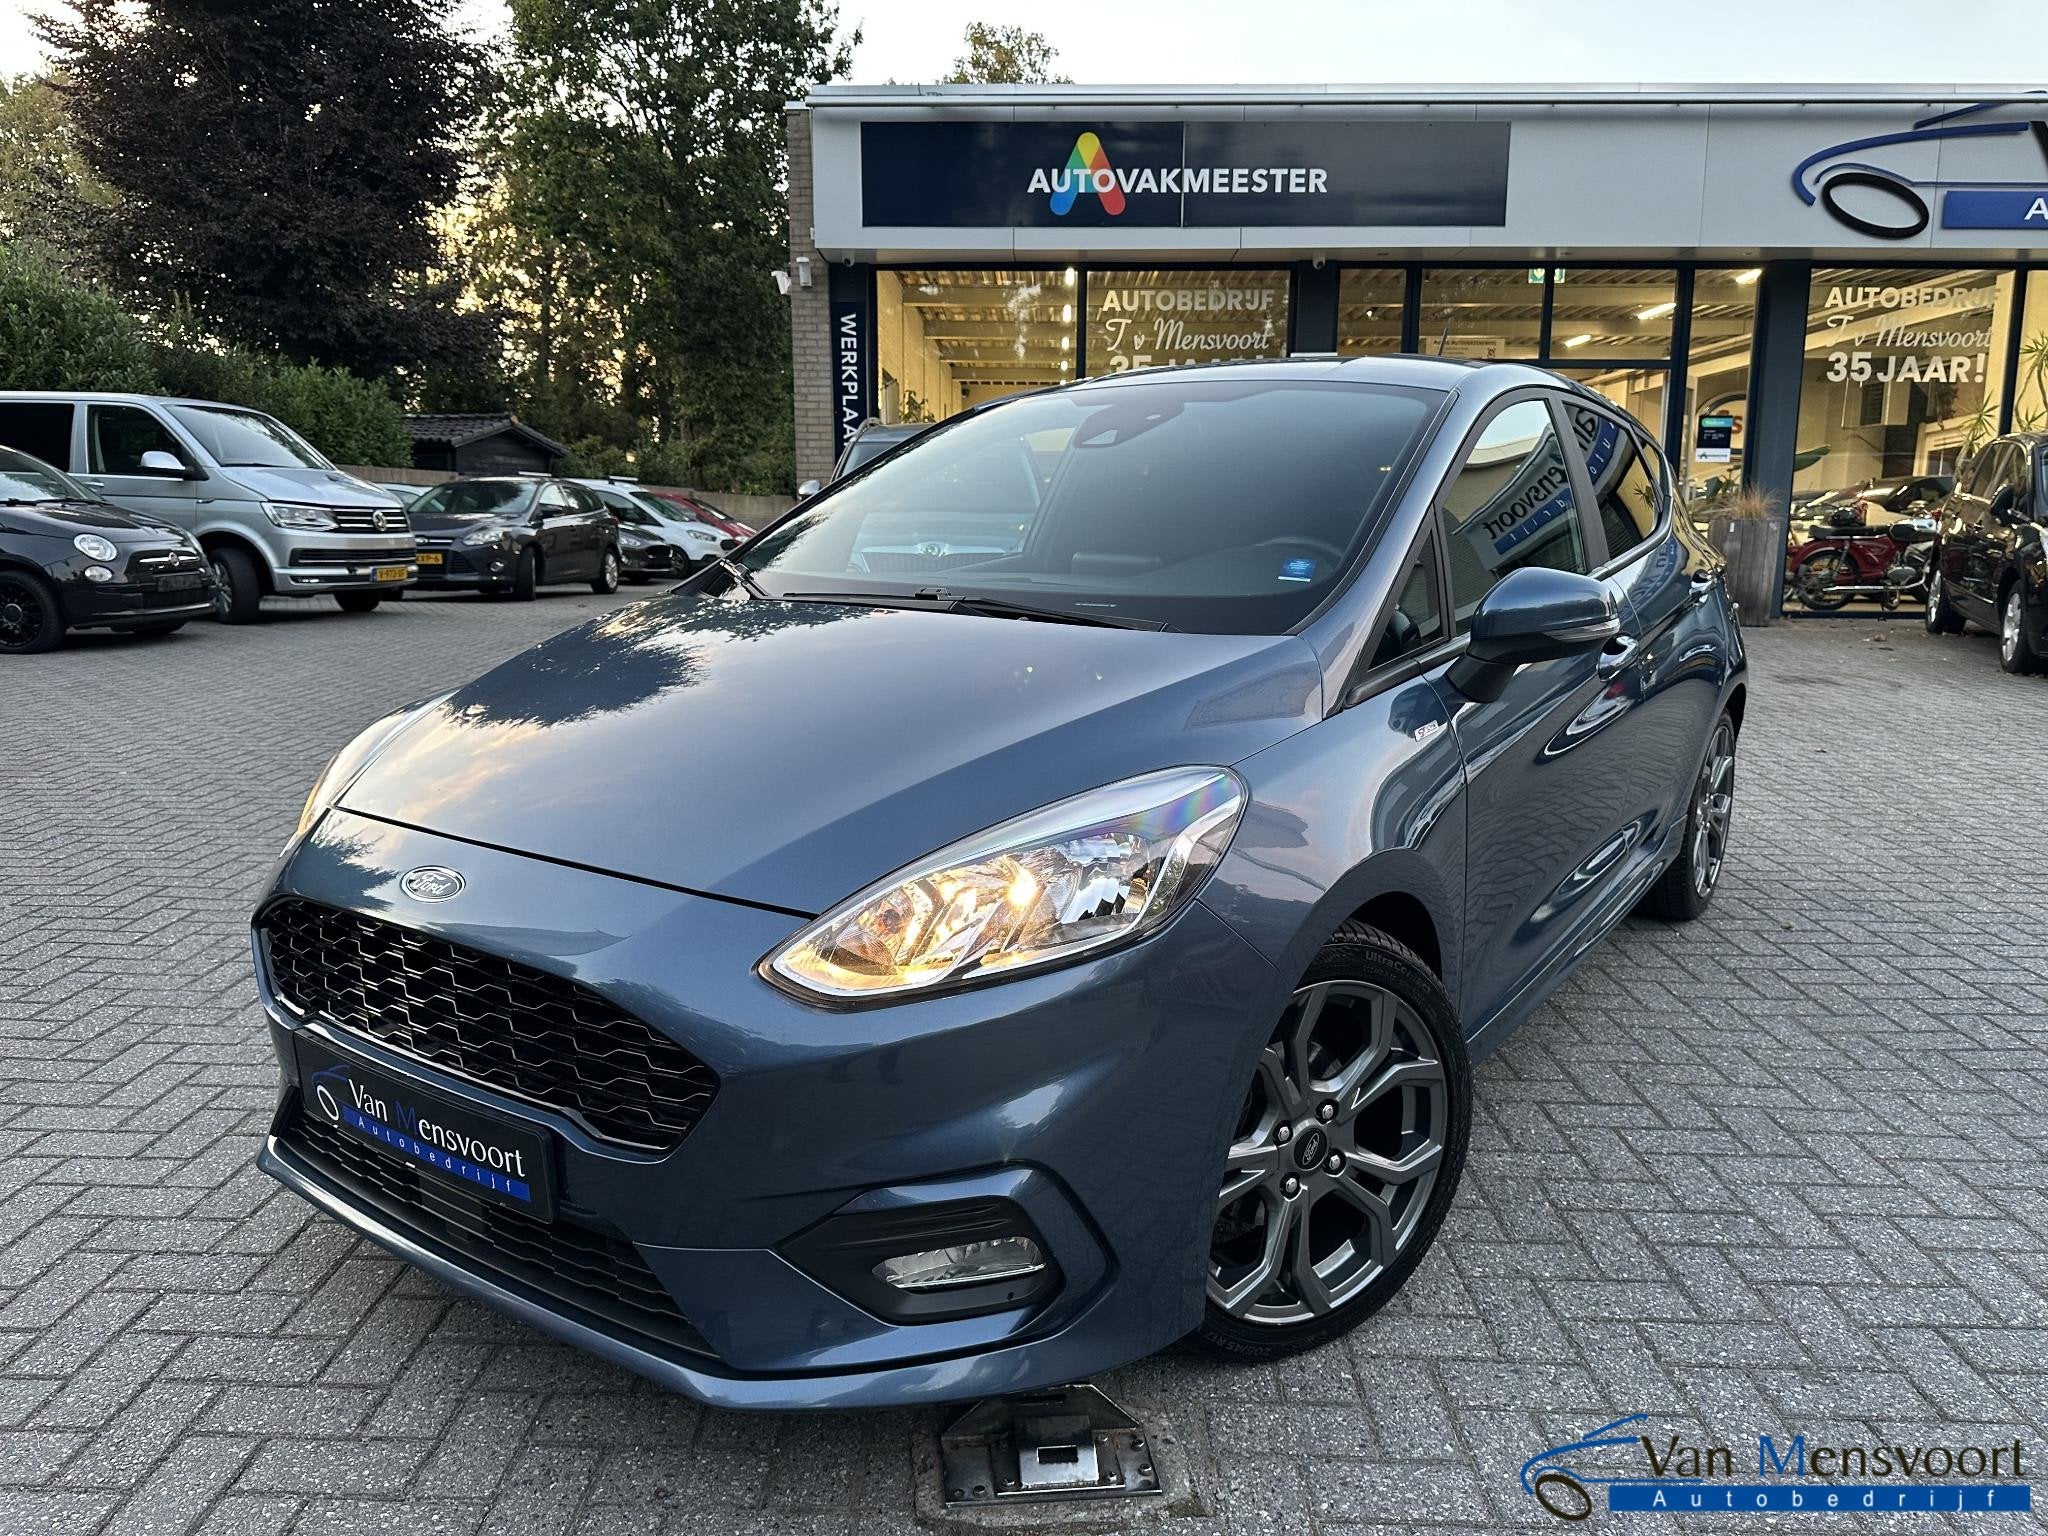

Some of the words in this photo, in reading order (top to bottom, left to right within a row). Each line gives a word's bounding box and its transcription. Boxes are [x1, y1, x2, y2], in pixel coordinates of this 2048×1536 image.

[1027, 167, 1328, 195] AUTOVAKMEESTER
[1102, 289, 1275, 312] AUTOBEDRIJF
[1154, 317, 1272, 351] Mensvoort
[1875, 316, 1992, 348] Mensvoort
[840, 313, 859, 446] WERKPLAA
[1826, 351, 1872, 383] 35
[1877, 352, 1986, 383] JAAR!
[412, 872, 451, 895] Ford
[348, 1077, 388, 1122] Van
[396, 1100, 526, 1178] Mensvoort
